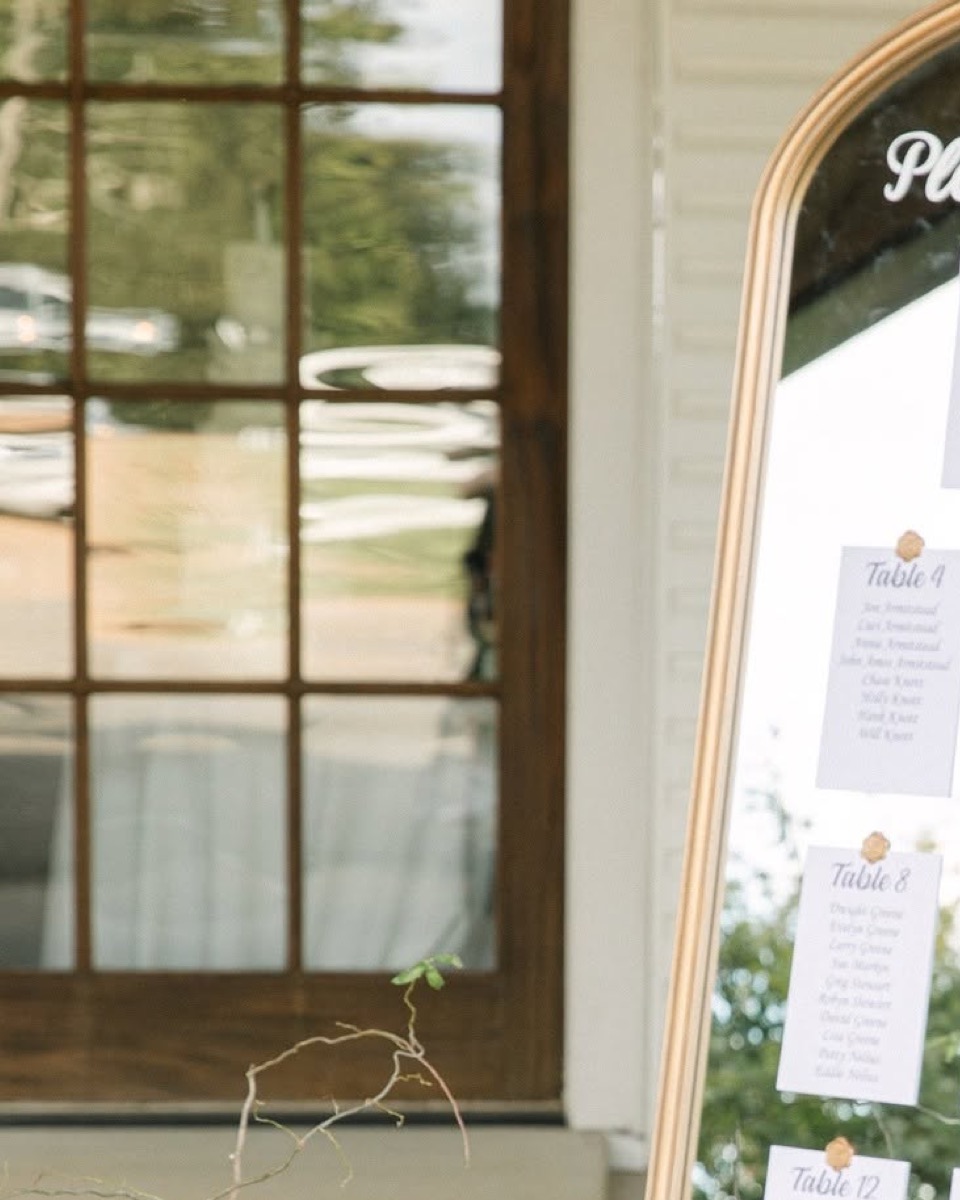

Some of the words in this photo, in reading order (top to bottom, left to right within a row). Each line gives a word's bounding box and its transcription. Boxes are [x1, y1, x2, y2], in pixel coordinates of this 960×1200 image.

[866, 561, 925, 590] Table
[931, 563, 946, 590] 4
[831, 862, 890, 892] Table
[895, 867, 912, 893] 8
[790, 1166, 851, 1198] Table
[857, 1174, 881, 1200] 12
